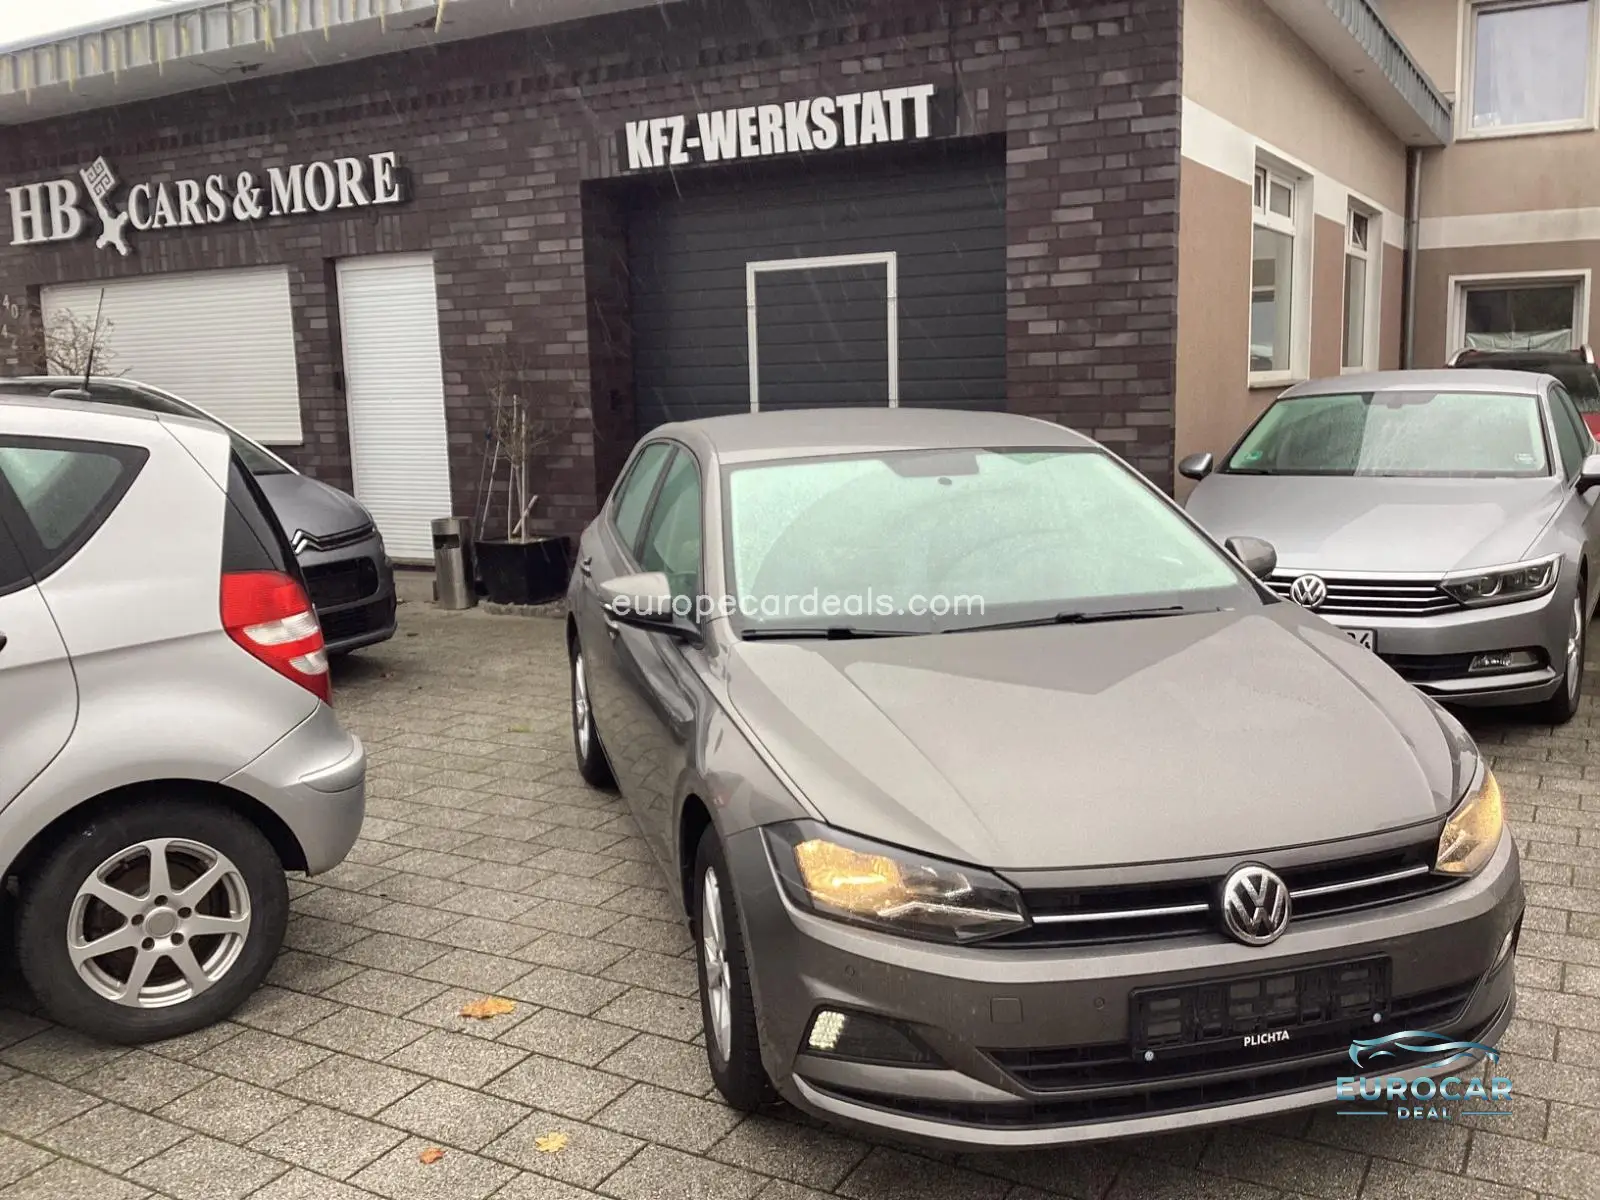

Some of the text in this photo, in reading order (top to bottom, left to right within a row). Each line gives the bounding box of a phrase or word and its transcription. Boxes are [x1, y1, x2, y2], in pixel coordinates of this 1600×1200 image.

[625, 83, 934, 170] KFZ-WERKSTATT
[5, 179, 81, 245] HB
[1243, 1029, 1290, 1047] PLICHTA
